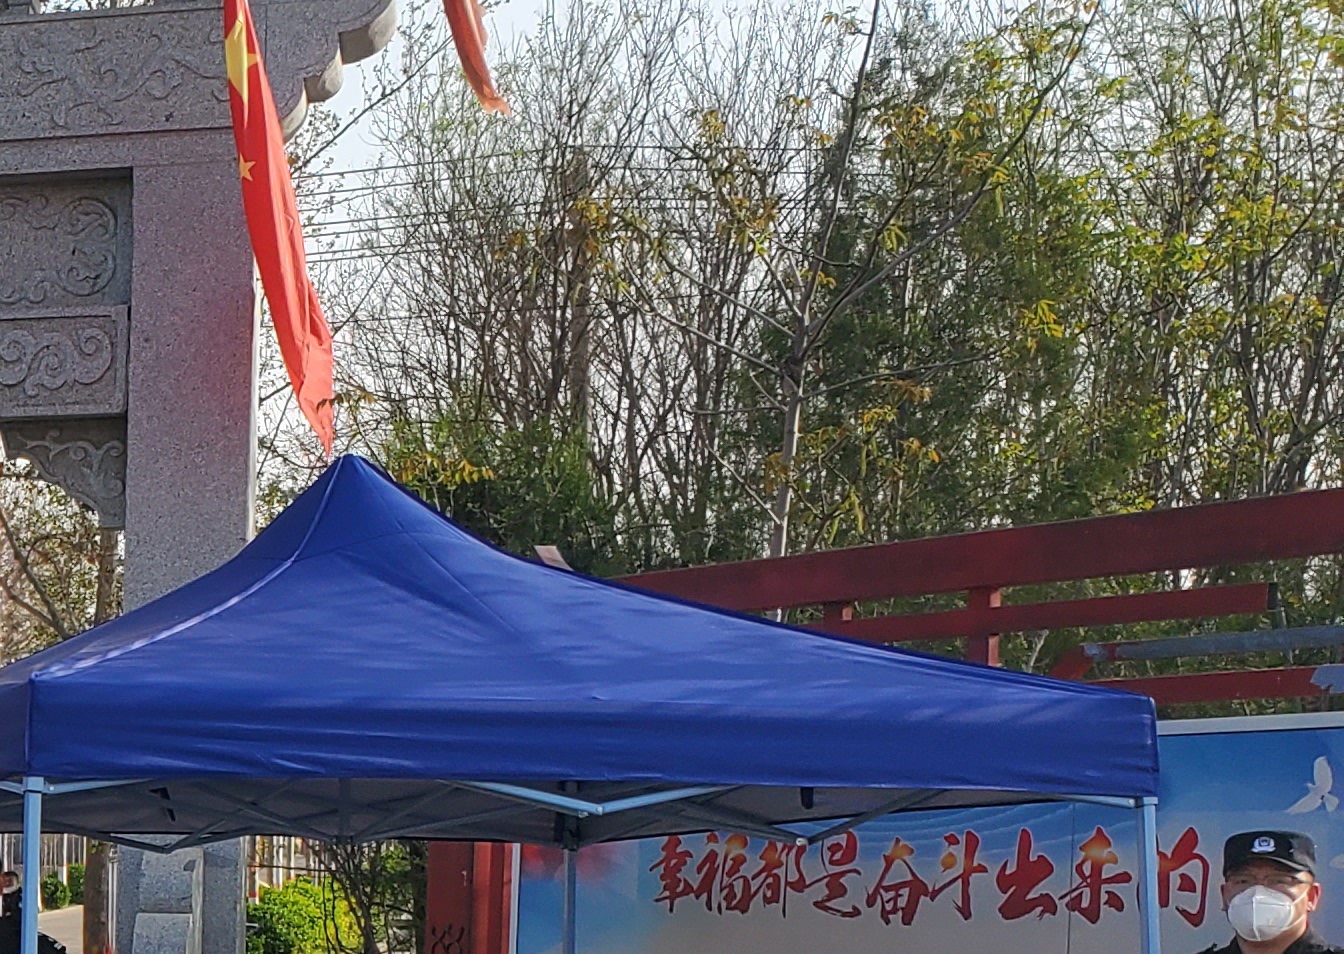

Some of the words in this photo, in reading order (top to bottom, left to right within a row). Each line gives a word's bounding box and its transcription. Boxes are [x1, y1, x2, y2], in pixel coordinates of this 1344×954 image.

[649, 826, 1210, 928] 幸福都是奋斗出来的
